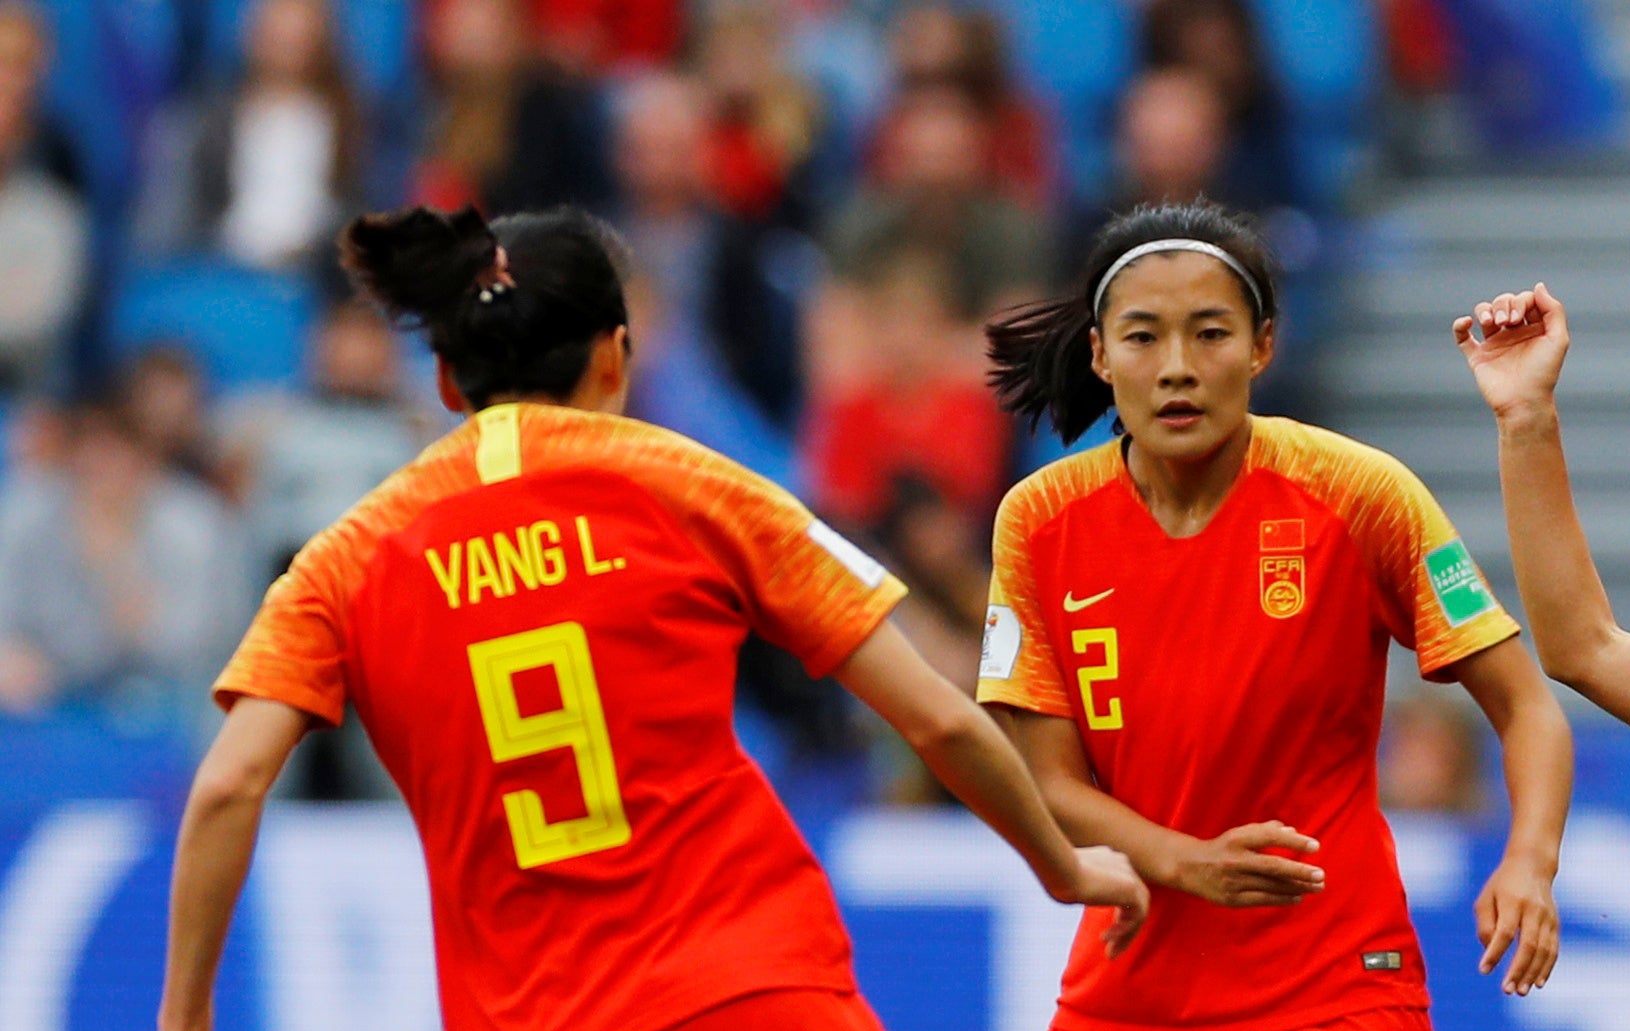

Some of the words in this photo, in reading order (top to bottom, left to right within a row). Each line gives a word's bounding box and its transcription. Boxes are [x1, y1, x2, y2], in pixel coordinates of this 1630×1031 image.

[424, 519, 567, 609] YANG
[576, 515, 627, 577] L.
[1264, 560, 1300, 573] CFA
[1072, 626, 1124, 731] 2
[466, 620, 632, 870] 9
